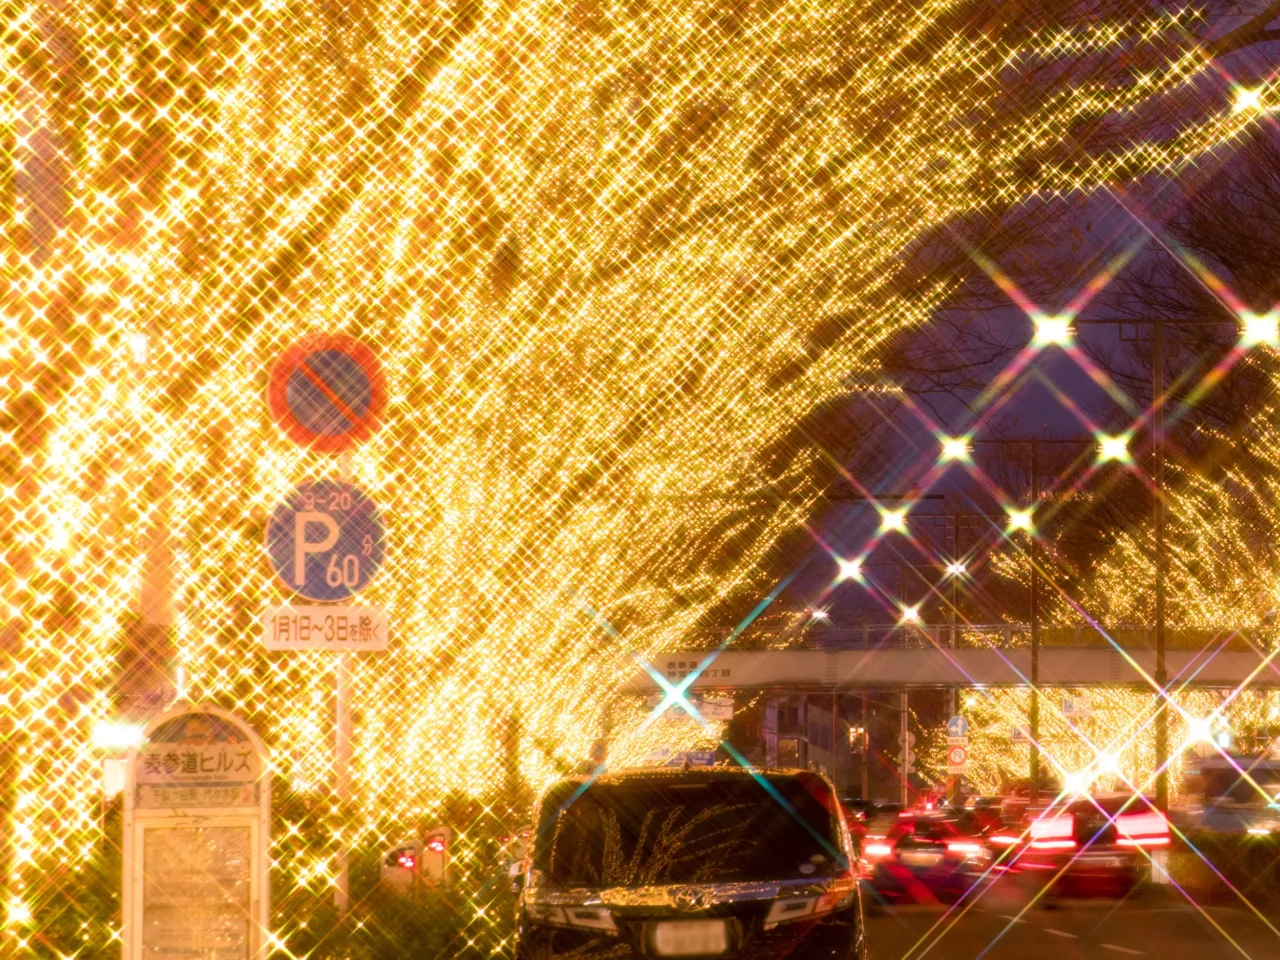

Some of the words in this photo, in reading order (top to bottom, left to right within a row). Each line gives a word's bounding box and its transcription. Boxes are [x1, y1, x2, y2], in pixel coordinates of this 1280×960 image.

[294, 511, 340, 586] P
[326, 553, 360, 588] 60
[143, 747, 252, 775] 表参道ヒルズ
